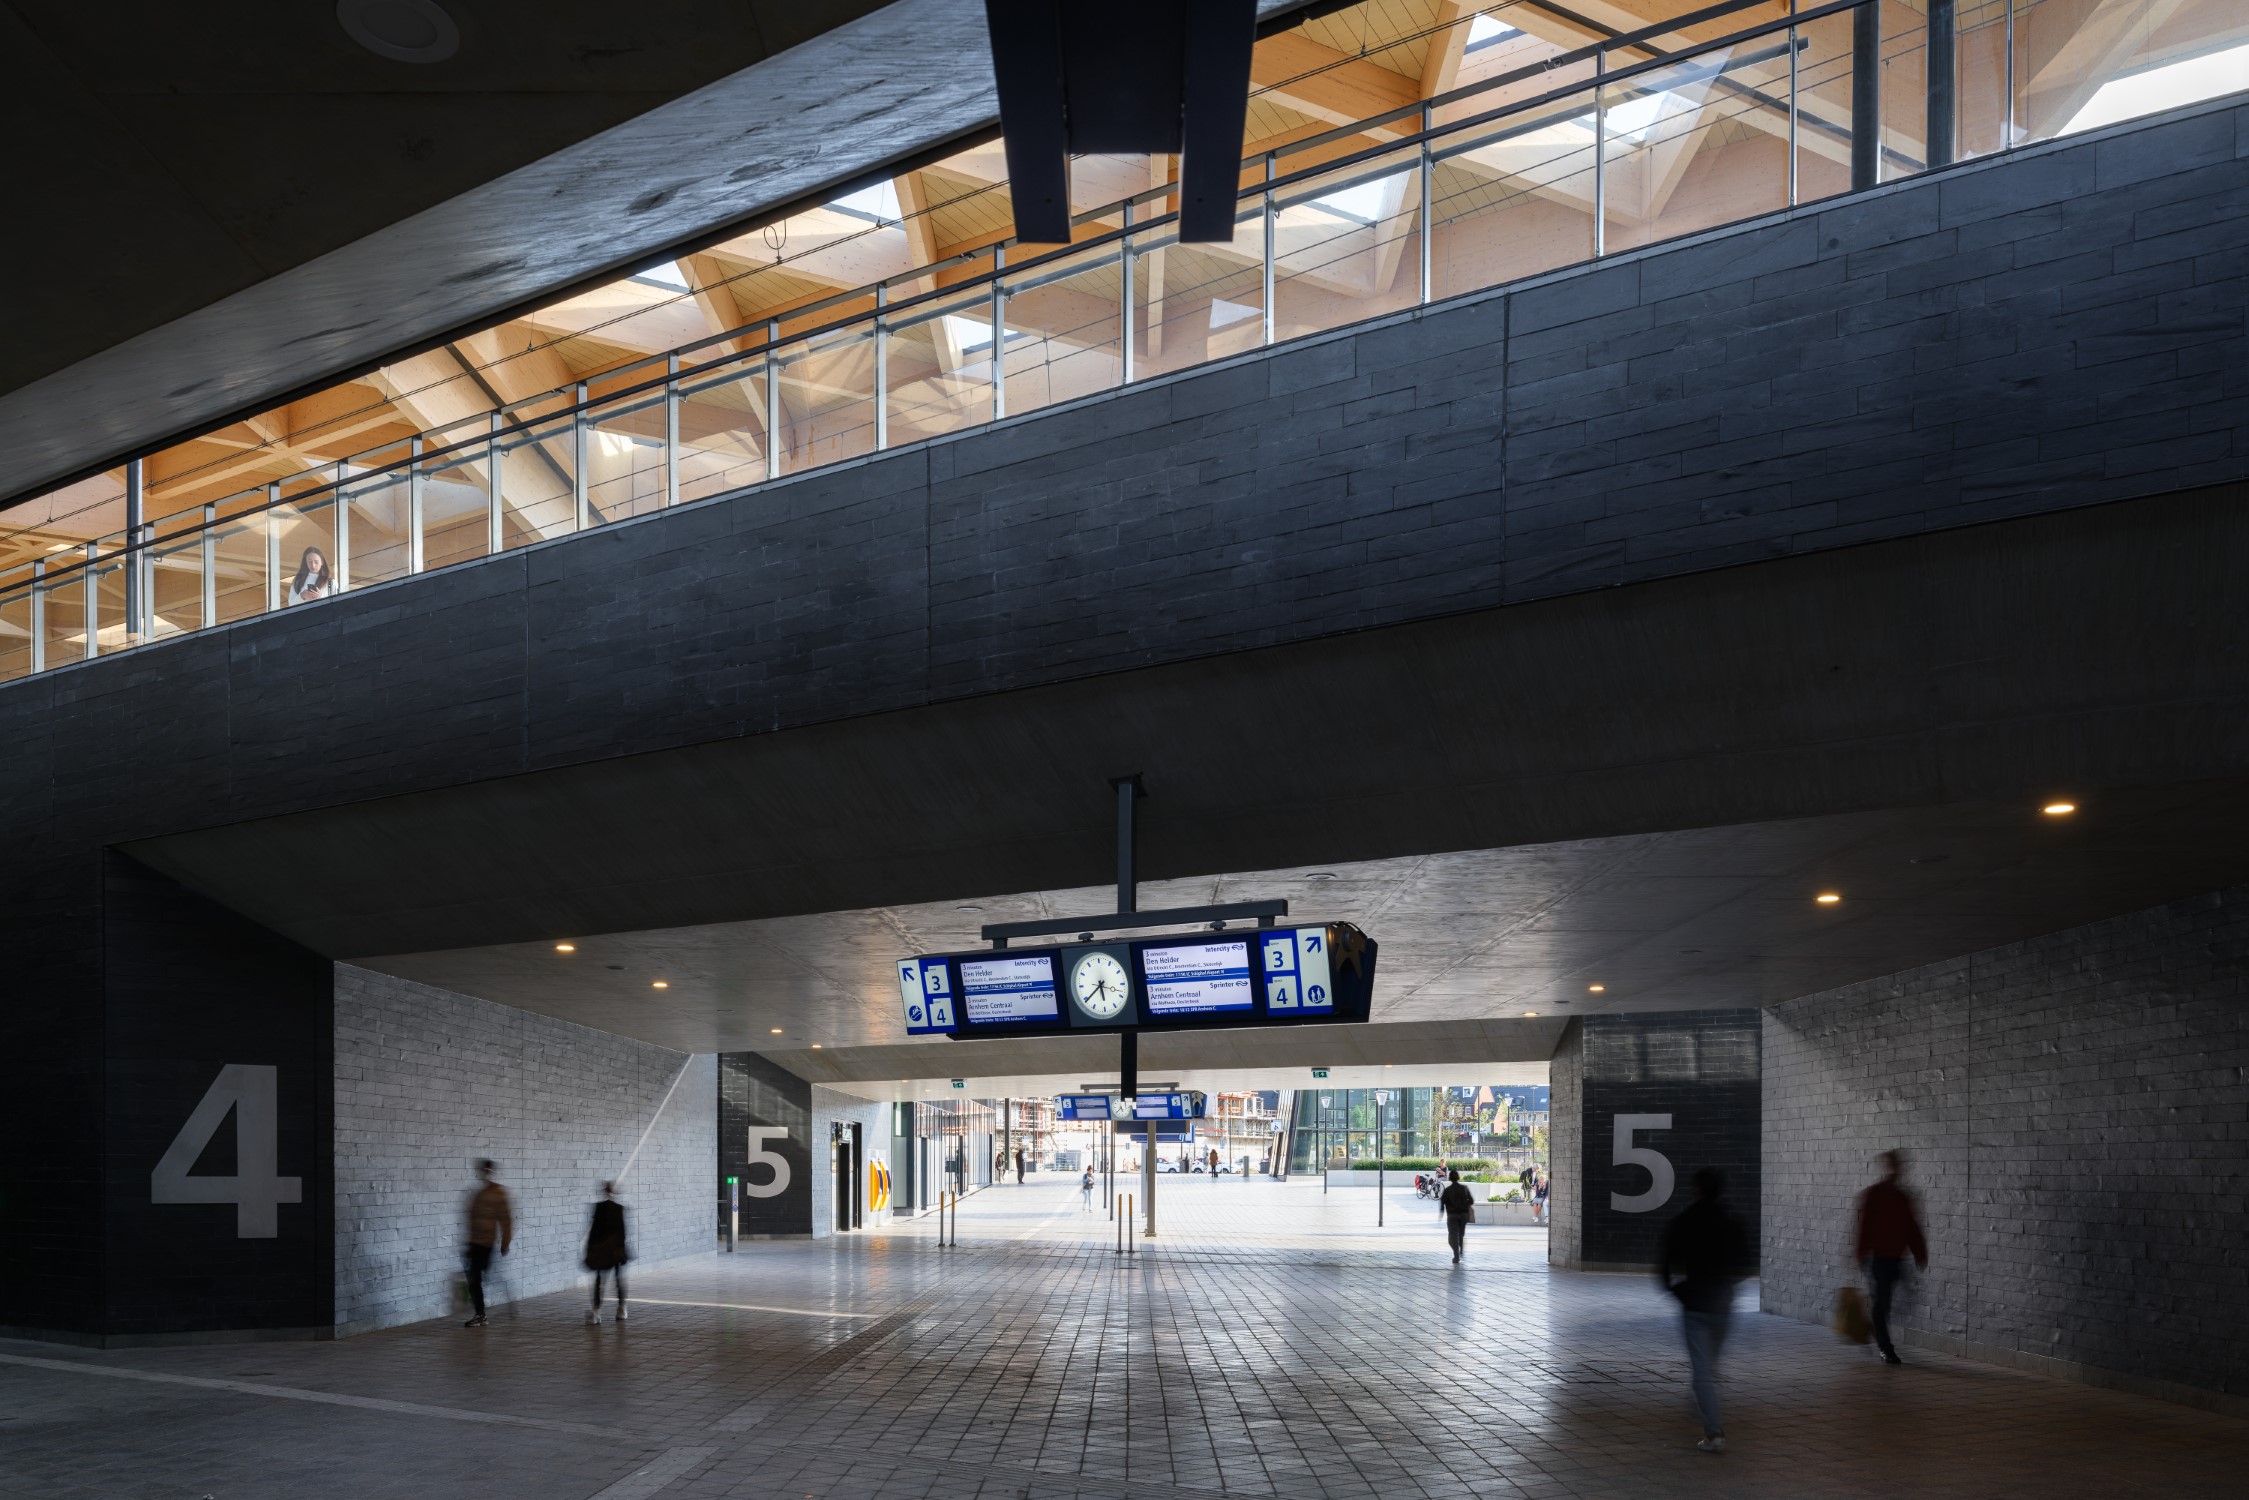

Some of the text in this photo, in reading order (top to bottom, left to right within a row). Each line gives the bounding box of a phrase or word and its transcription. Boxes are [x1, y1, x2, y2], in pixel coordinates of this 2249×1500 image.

[1205, 944, 1230, 953] Intercity
[1272, 950, 1284, 968] 3
[932, 976, 941, 992] 3
[1276, 988, 1288, 1004] 4
[937, 1008, 946, 1024] 4
[151, 1063, 303, 1239] 4
[747, 1126, 791, 1198] 5
[1610, 1113, 1675, 1213] 5
